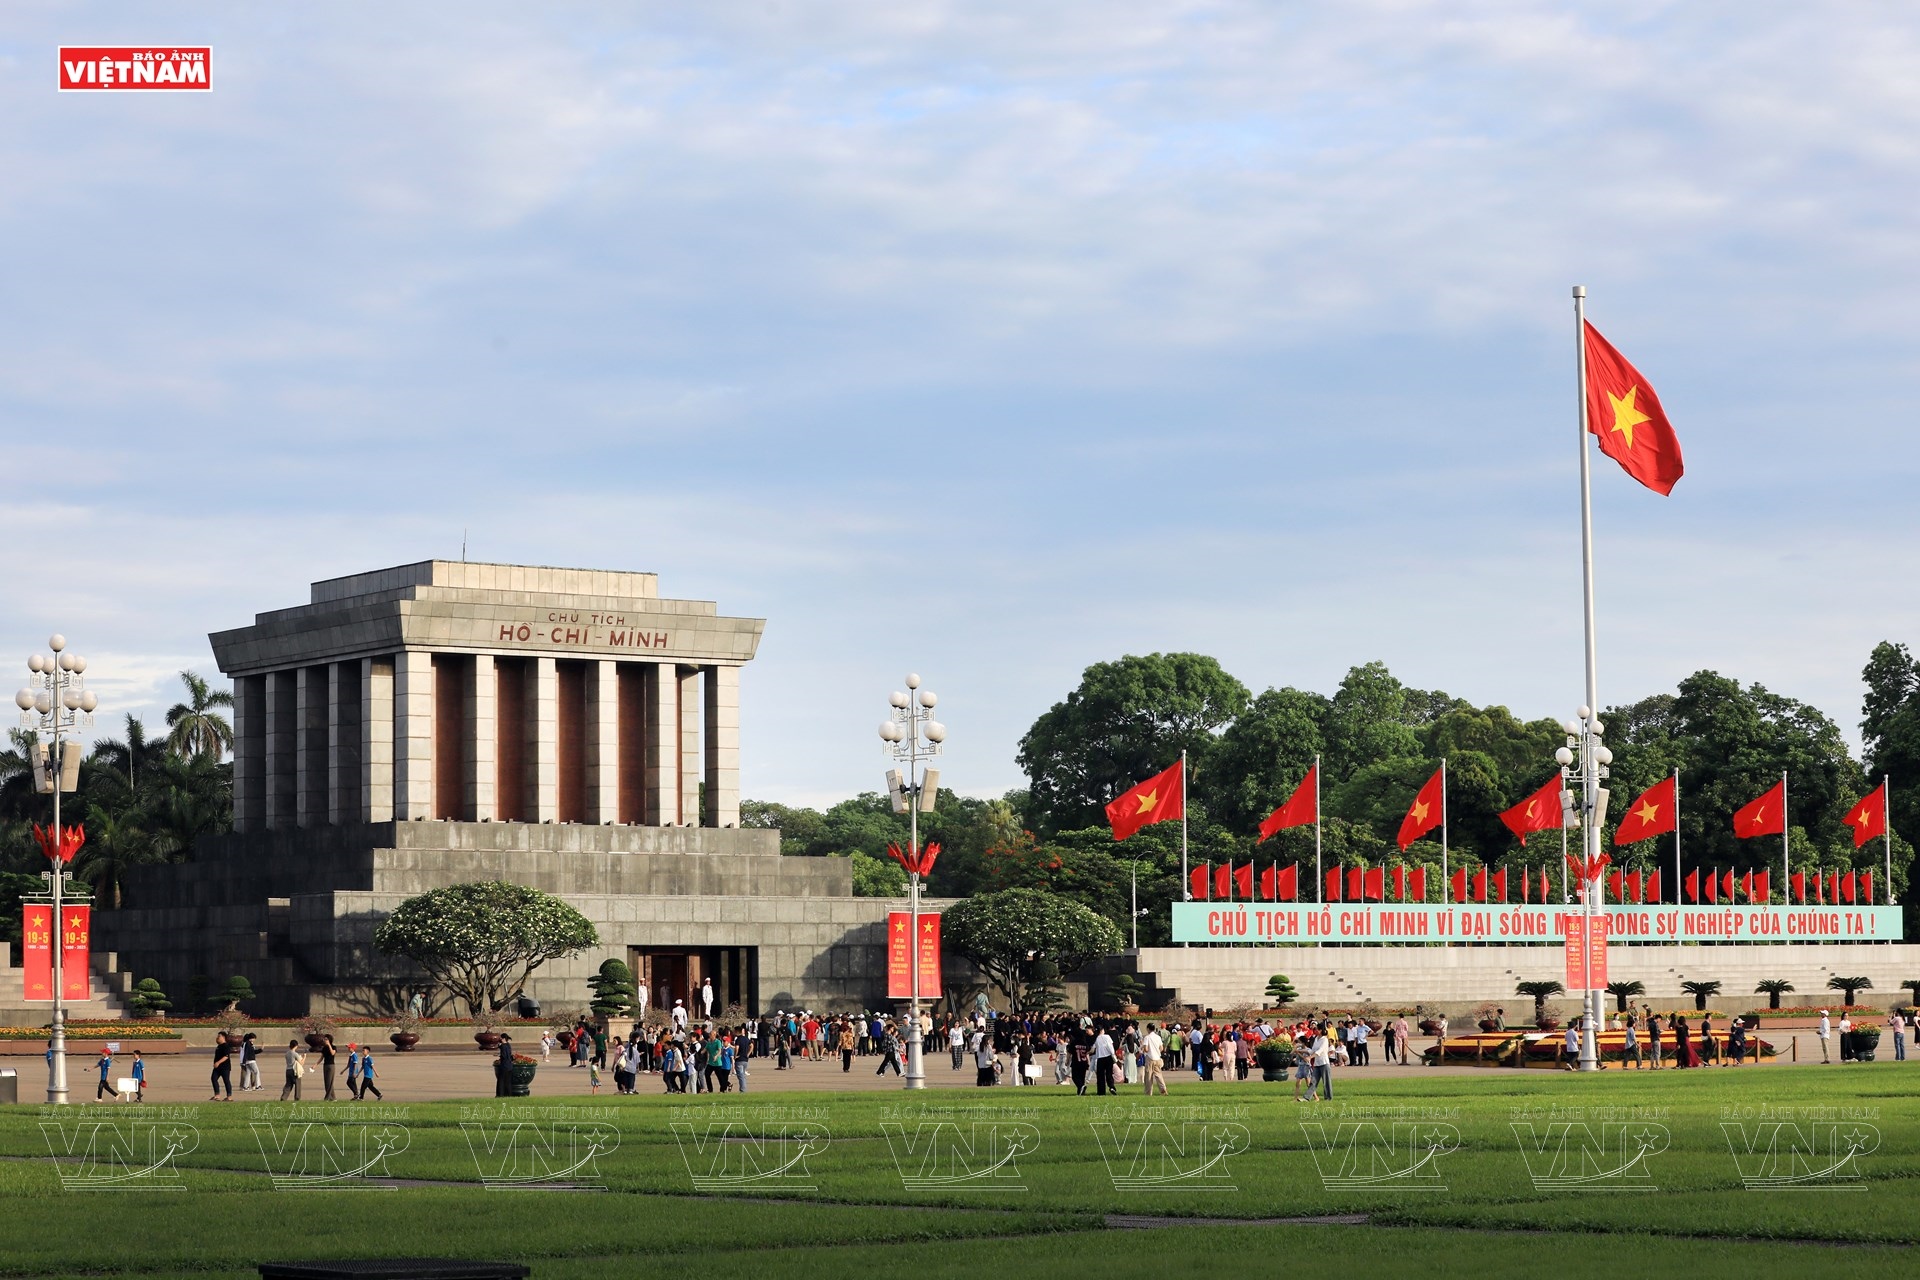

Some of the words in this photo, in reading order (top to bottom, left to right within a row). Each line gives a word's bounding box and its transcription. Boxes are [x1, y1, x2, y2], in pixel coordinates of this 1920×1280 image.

[591, 612, 625, 628] TỊCH
[499, 622, 533, 642] HỒ
[550, 625, 591, 645] CHÍ
[609, 627, 668, 649] MINH
[1208, 903, 1247, 936] CHỦ
[1255, 911, 1299, 940] TỊCH
[1307, 903, 1332, 936] HỒ
[1340, 906, 1371, 936] CHÍ
[1379, 911, 1428, 936] MINH
[1436, 907, 1454, 936] VĨ
[1461, 912, 1491, 940] ĐẠI
[1499, 904, 1547, 936] SỐNG
[1604, 912, 1650, 936] RONG
[1656, 909, 1679, 939] SỰ
[1684, 908, 1744, 939] NGHIỆP
[1749, 906, 1781, 935] CỦA
[1787, 908, 1839, 935] CHÚNG
[1845, 912, 1864, 935] TA
[1870, 913, 1875, 935] !
[27, 931, 49, 944] 19-5
[65, 931, 88, 945] 19-5
